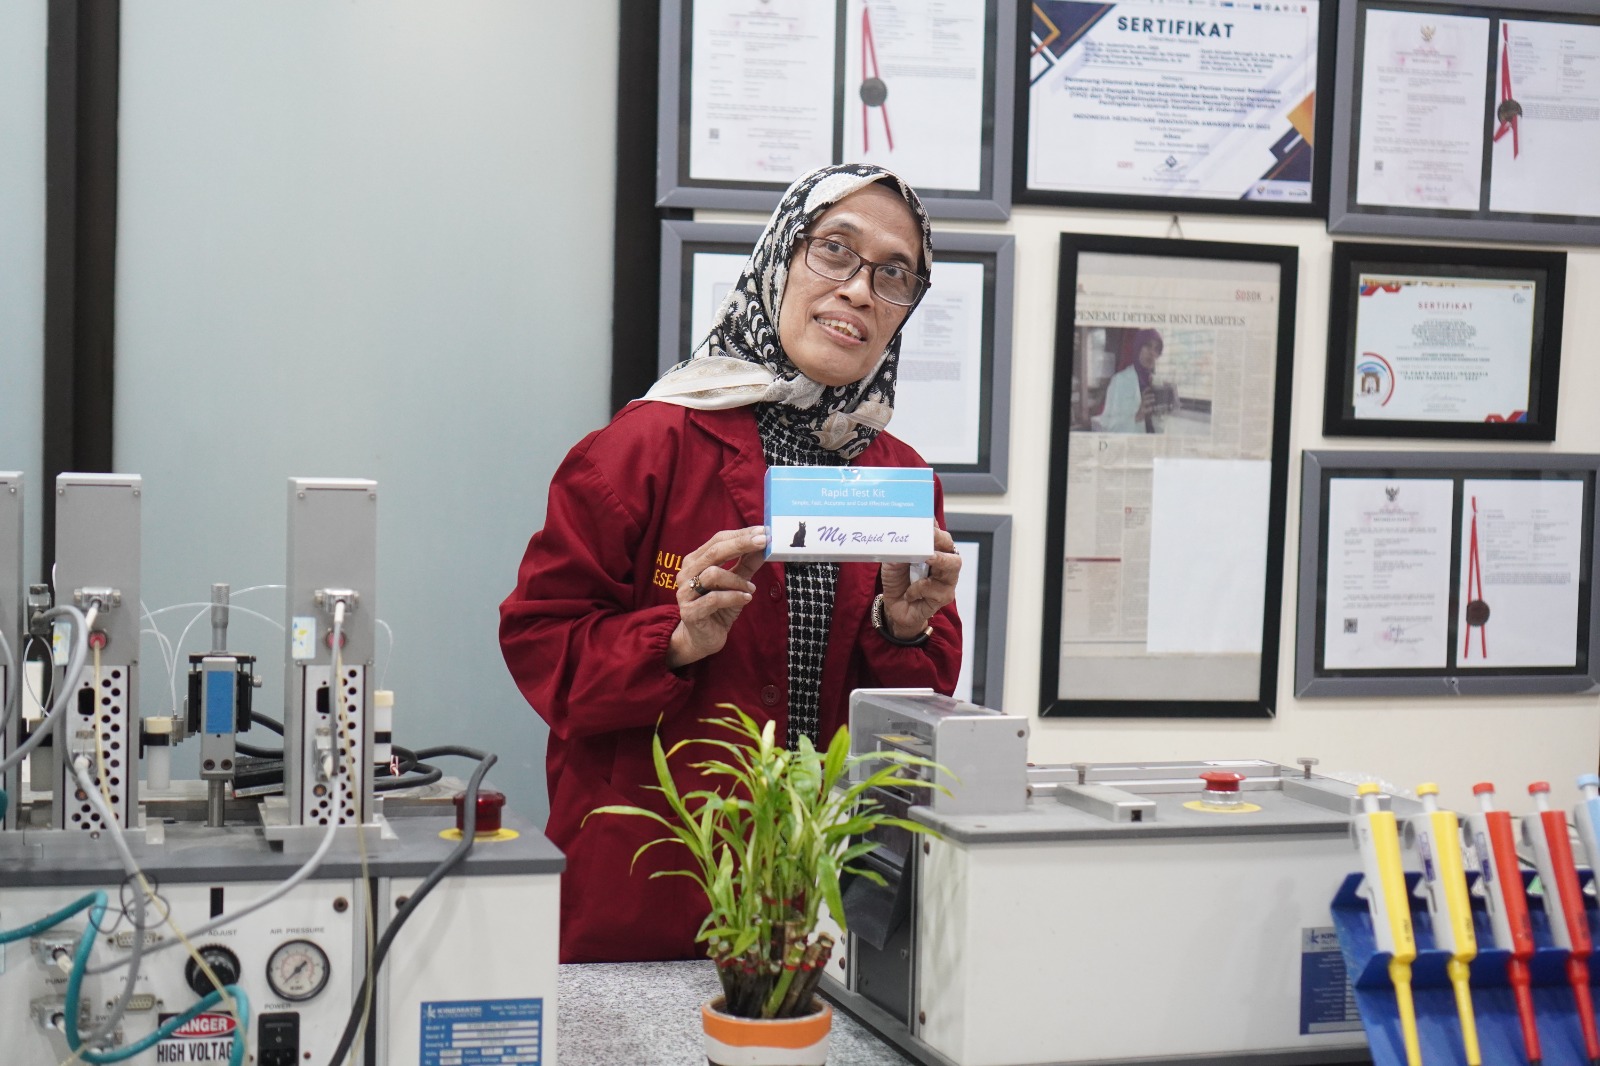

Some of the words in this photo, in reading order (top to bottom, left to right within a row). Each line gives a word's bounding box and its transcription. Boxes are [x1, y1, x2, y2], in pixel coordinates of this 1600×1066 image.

[1117, 15, 1235, 38] SERTIFIKAT
[1102, 78, 1132, 86] Diamond
[1073, 113, 1110, 122] INDONESIA
[1112, 115, 1156, 124] HEALTHCARE
[1158, 118, 1200, 126] INNOVATION
[1418, 302, 1473, 310] SERTIFIKAT
[1074, 310, 1120, 322] PENEMU
[1122, 312, 1166, 324] DETEKSI
[1169, 313, 1193, 324] DINI
[1195, 314, 1246, 326] DIABETES
[821, 488, 848, 498] Rapid
[852, 488, 870, 497] Test
[872, 488, 886, 498] Kit
[817, 526, 847, 547] My
[851, 532, 884, 546] Rapid
[887, 532, 910, 543] Test
[656, 550, 682, 571] AUL
[438, 1006, 482, 1014] KINEMATIC
[177, 1018, 228, 1033] ANGER
[157, 1044, 185, 1063] HIGH
[188, 1042, 234, 1062] VOLTAG
